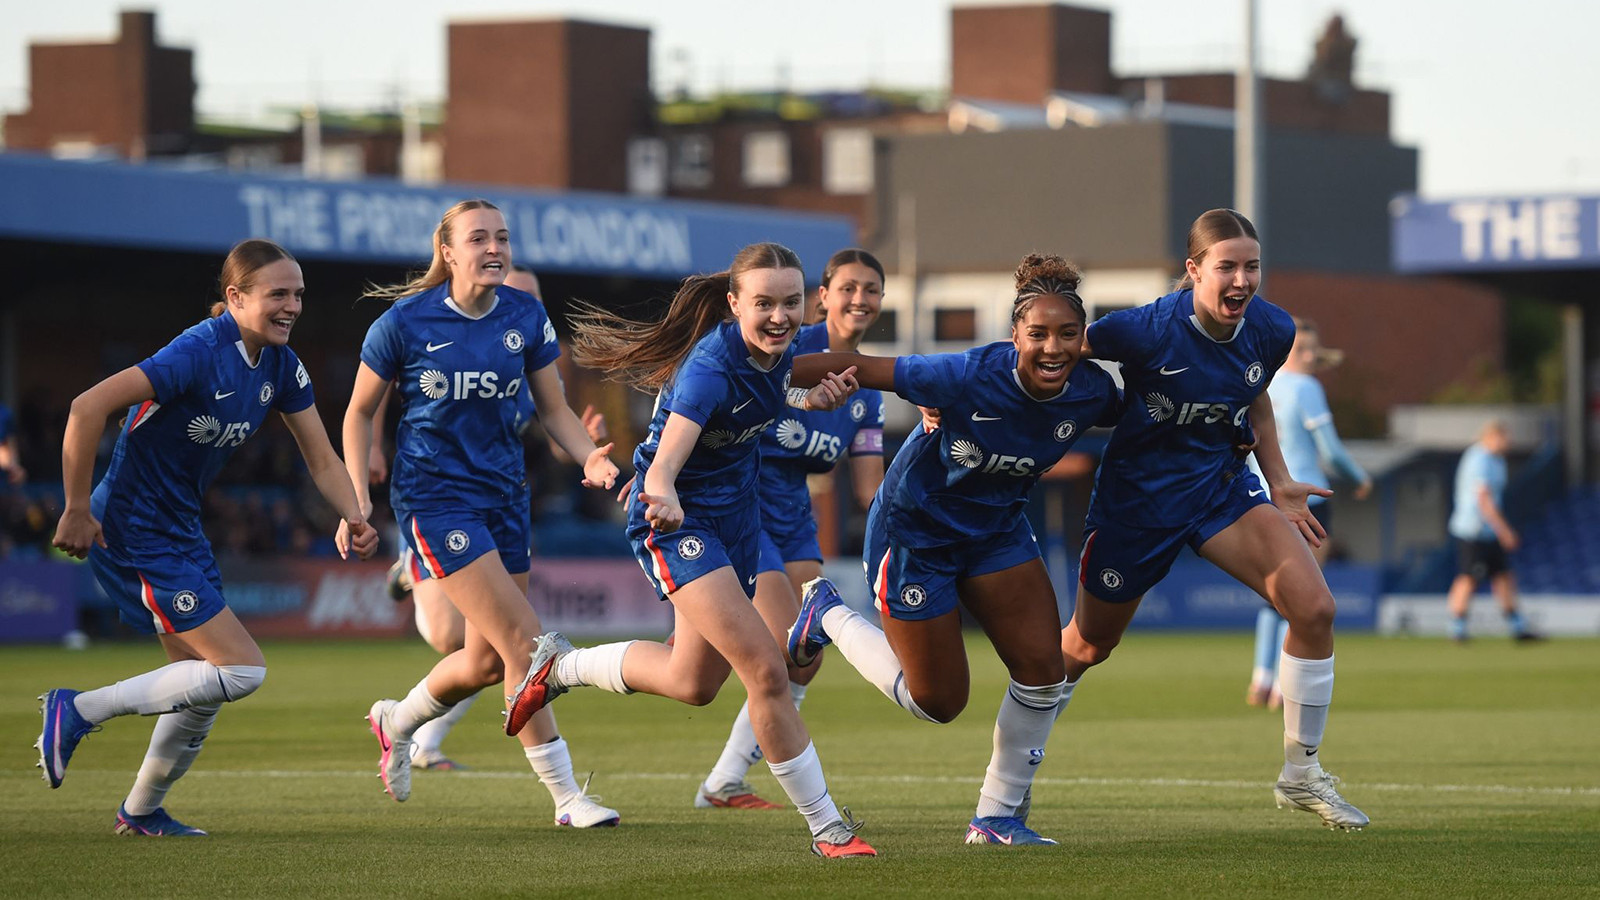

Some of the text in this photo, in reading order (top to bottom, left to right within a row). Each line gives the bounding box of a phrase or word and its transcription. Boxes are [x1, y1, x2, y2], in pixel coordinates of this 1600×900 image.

[239, 186, 333, 249] THE
[519, 204, 692, 271] LONDON
[1449, 200, 1581, 261] THE
